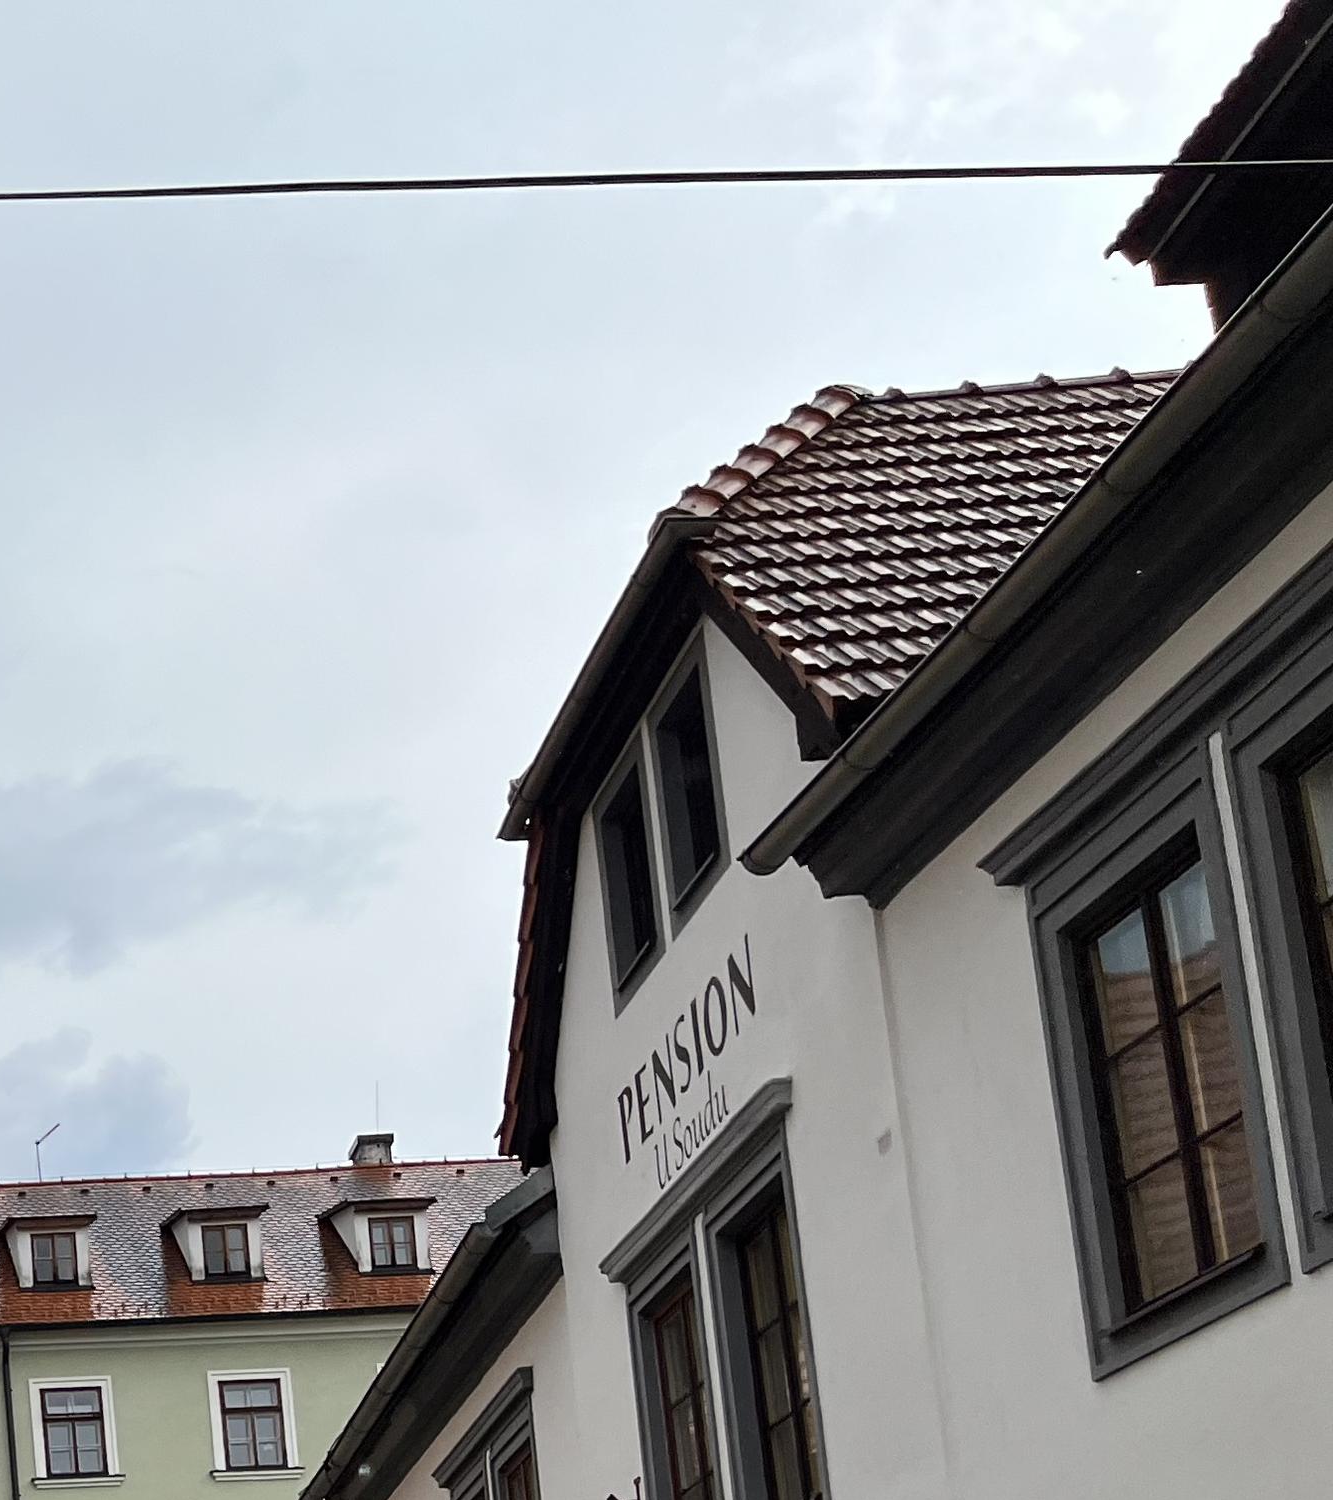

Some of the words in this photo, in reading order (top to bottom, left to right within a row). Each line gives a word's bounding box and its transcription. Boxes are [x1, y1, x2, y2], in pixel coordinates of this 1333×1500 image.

[617, 932, 756, 1165] PENSION
[654, 1133, 671, 1190] U
[673, 1070, 729, 1171] Soudu
